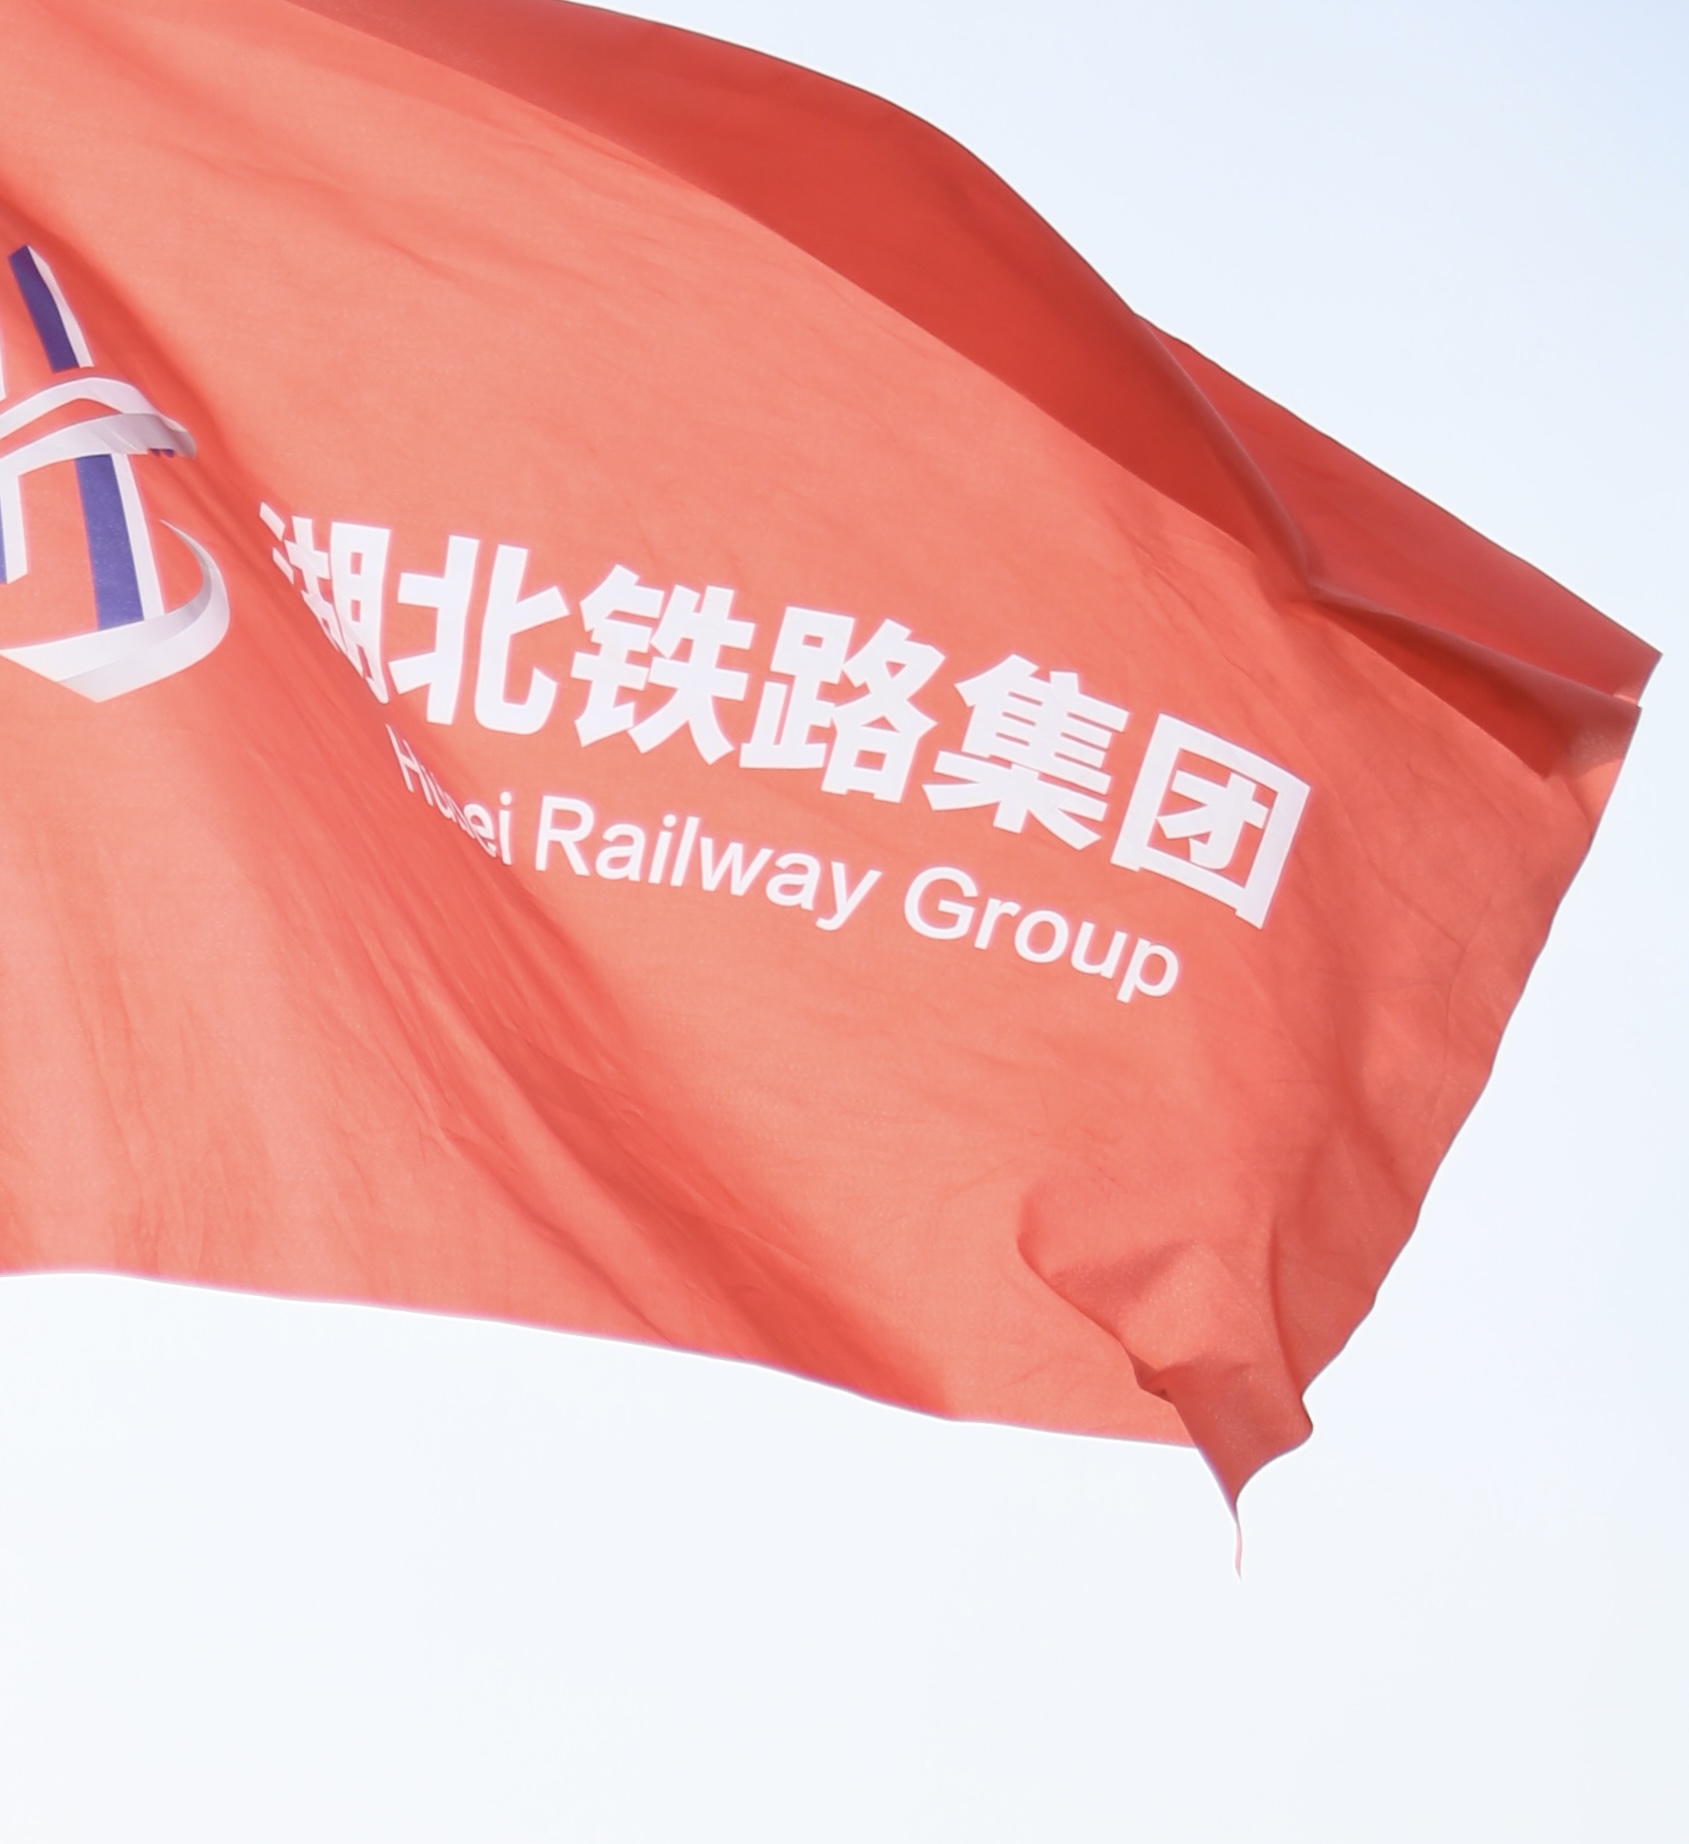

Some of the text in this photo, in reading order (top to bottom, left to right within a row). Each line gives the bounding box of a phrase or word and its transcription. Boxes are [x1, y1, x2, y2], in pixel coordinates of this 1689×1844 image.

[259, 500, 1311, 930] 湖北铁路集团
[534, 795, 882, 932] Railway
[903, 865, 1180, 1004] Group
